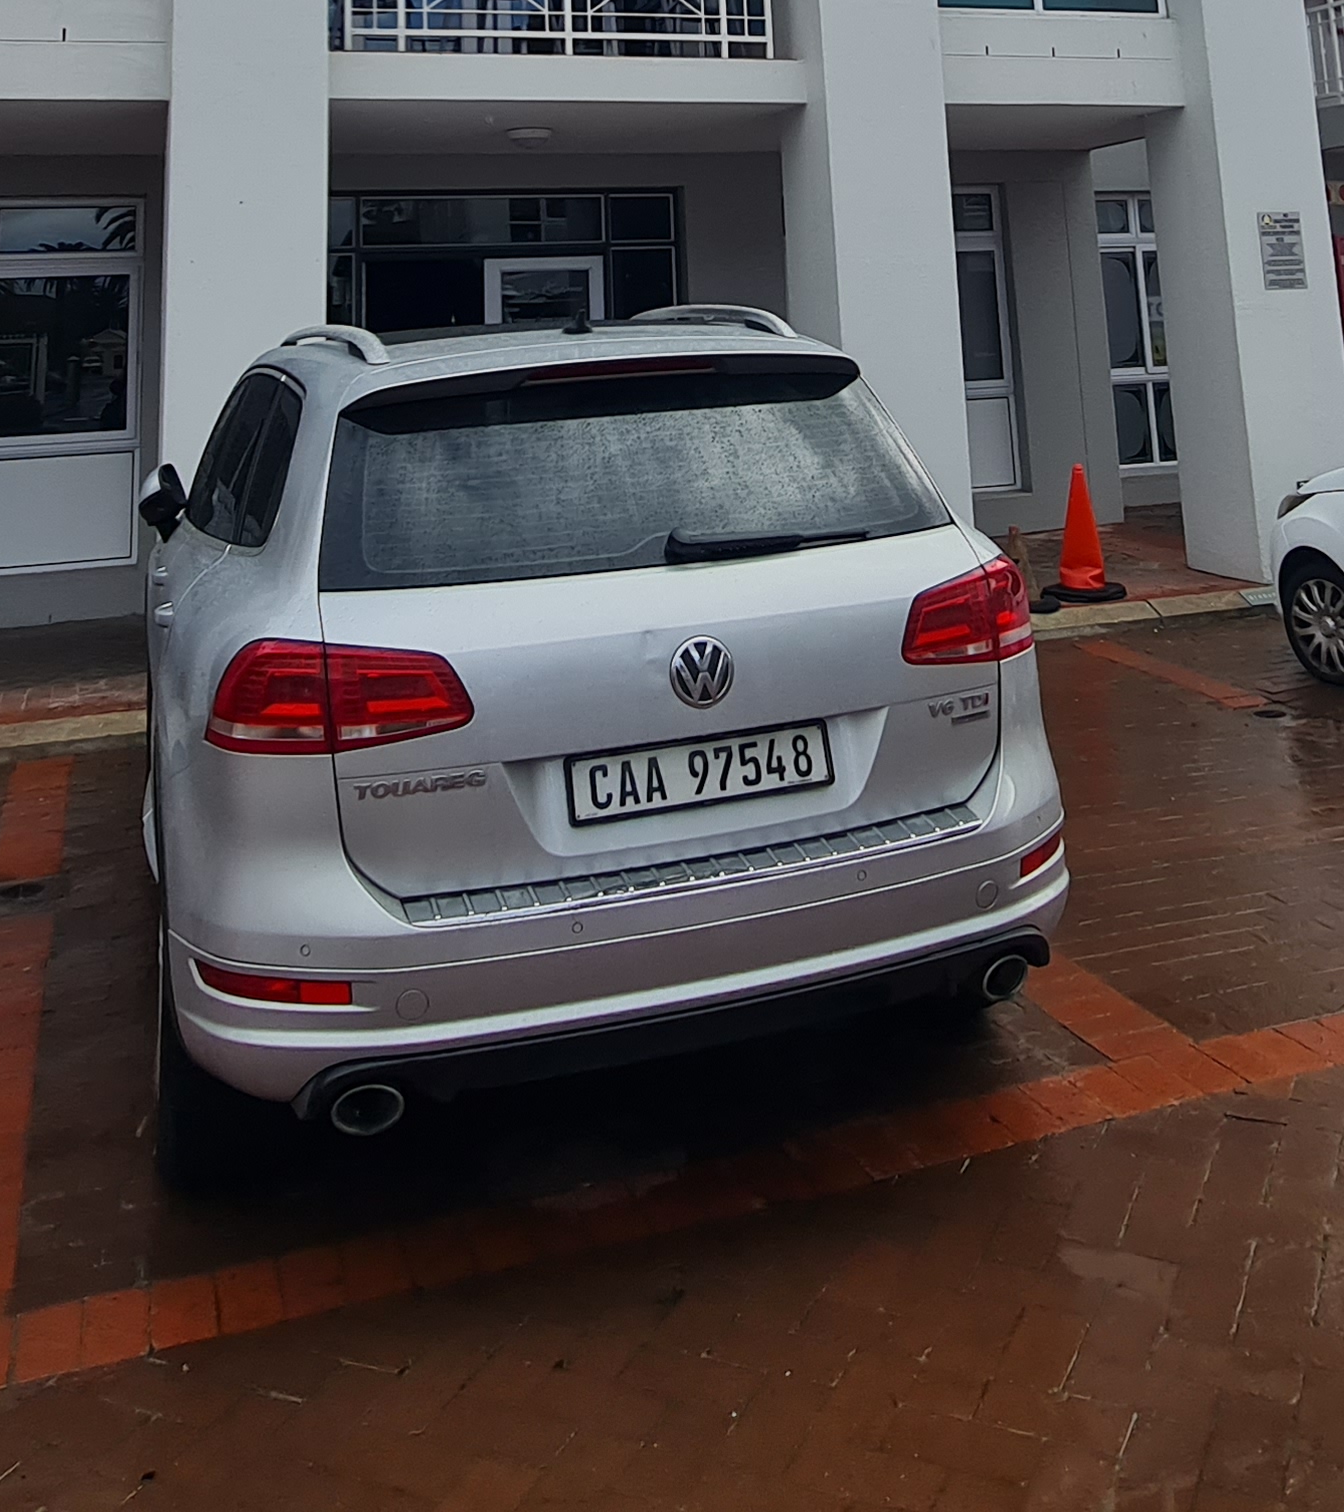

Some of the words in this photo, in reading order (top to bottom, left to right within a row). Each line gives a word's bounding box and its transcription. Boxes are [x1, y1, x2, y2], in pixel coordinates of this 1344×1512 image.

[927, 697, 954, 718] V6
[959, 691, 990, 711] TDI
[353, 768, 488, 800] TOUAREG
[589, 756, 668, 810] CAA
[688, 734, 813, 796] 97548
